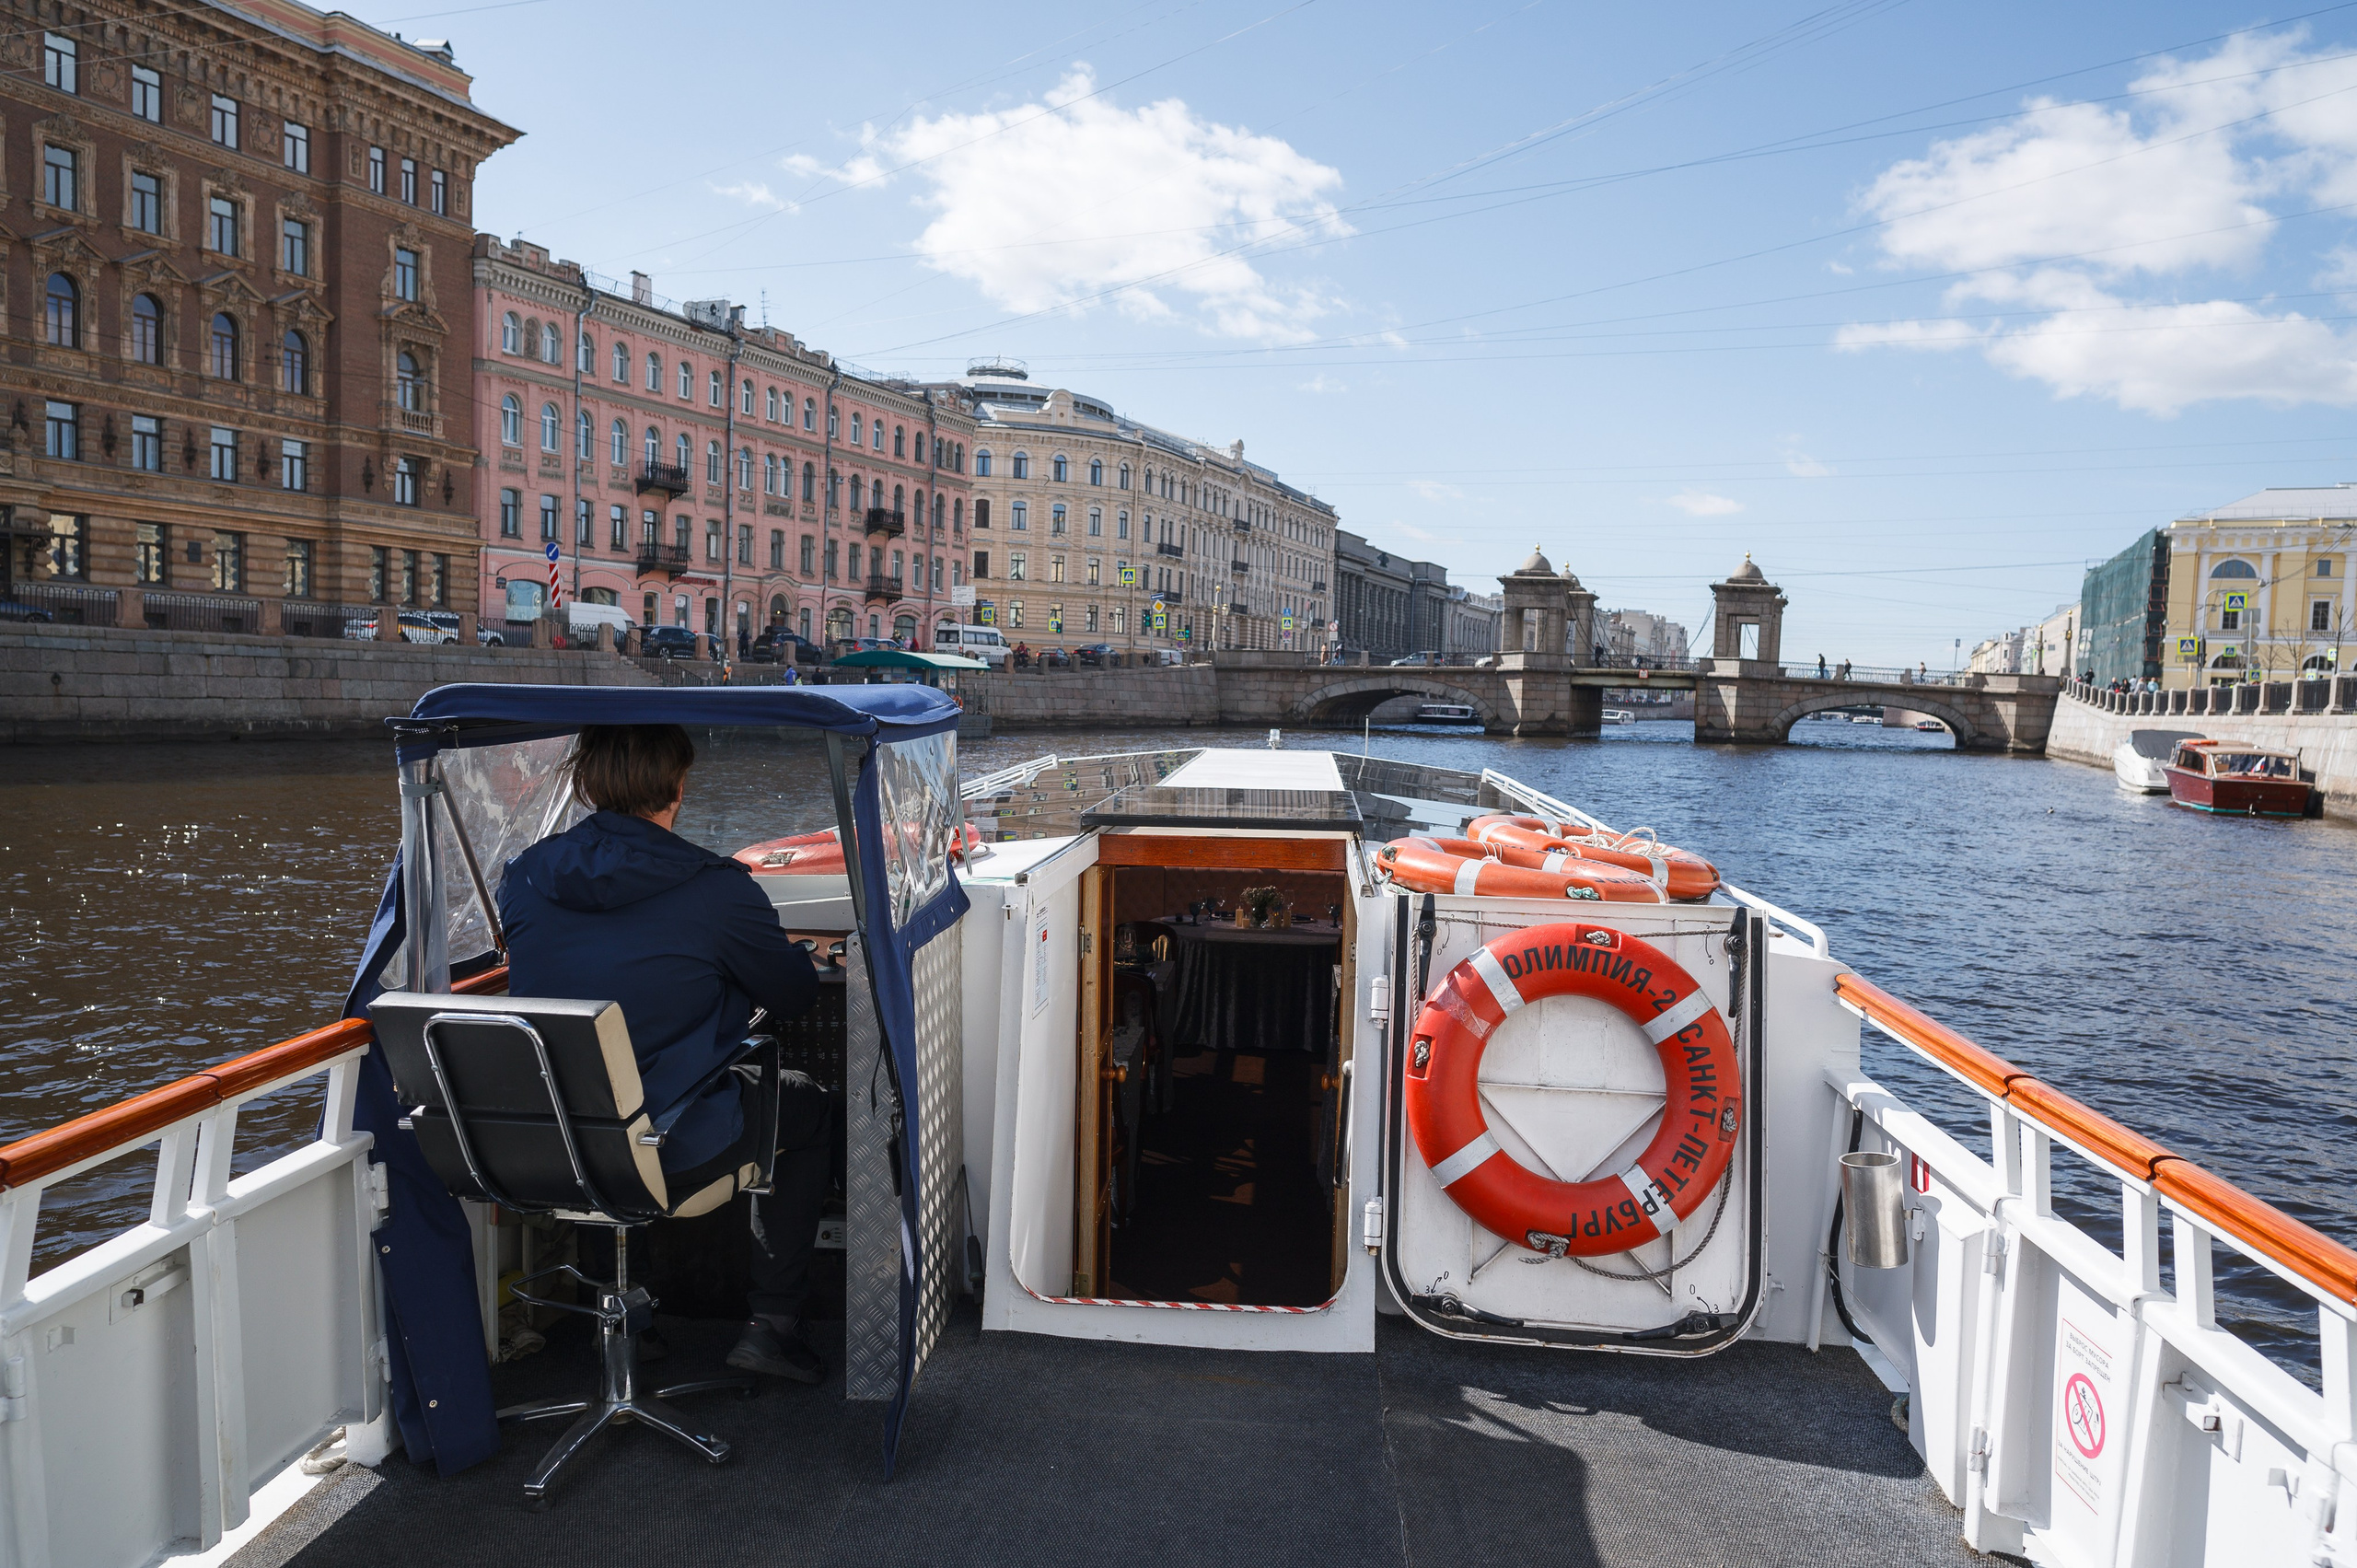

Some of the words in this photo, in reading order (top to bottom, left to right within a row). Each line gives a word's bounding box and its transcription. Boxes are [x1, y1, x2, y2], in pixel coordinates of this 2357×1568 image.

[1503, 946, 1678, 1013] ОЛИМПИЯ-2
[1562, 1023, 1719, 1238] САНКТ-ПЕТЕРБУРГ
[2066, 1342, 2073, 1351] ЗА
[2073, 1347, 2085, 1363] БОРТ
[2085, 1357, 2111, 1384] ЗАПРЕЩЕН
[2070, 1332, 2088, 1353] ВЫБРОС
[2088, 1348, 2110, 1370] МУСОРА
[2063, 1446, 2089, 1475] НАРУШЕНИЕ
